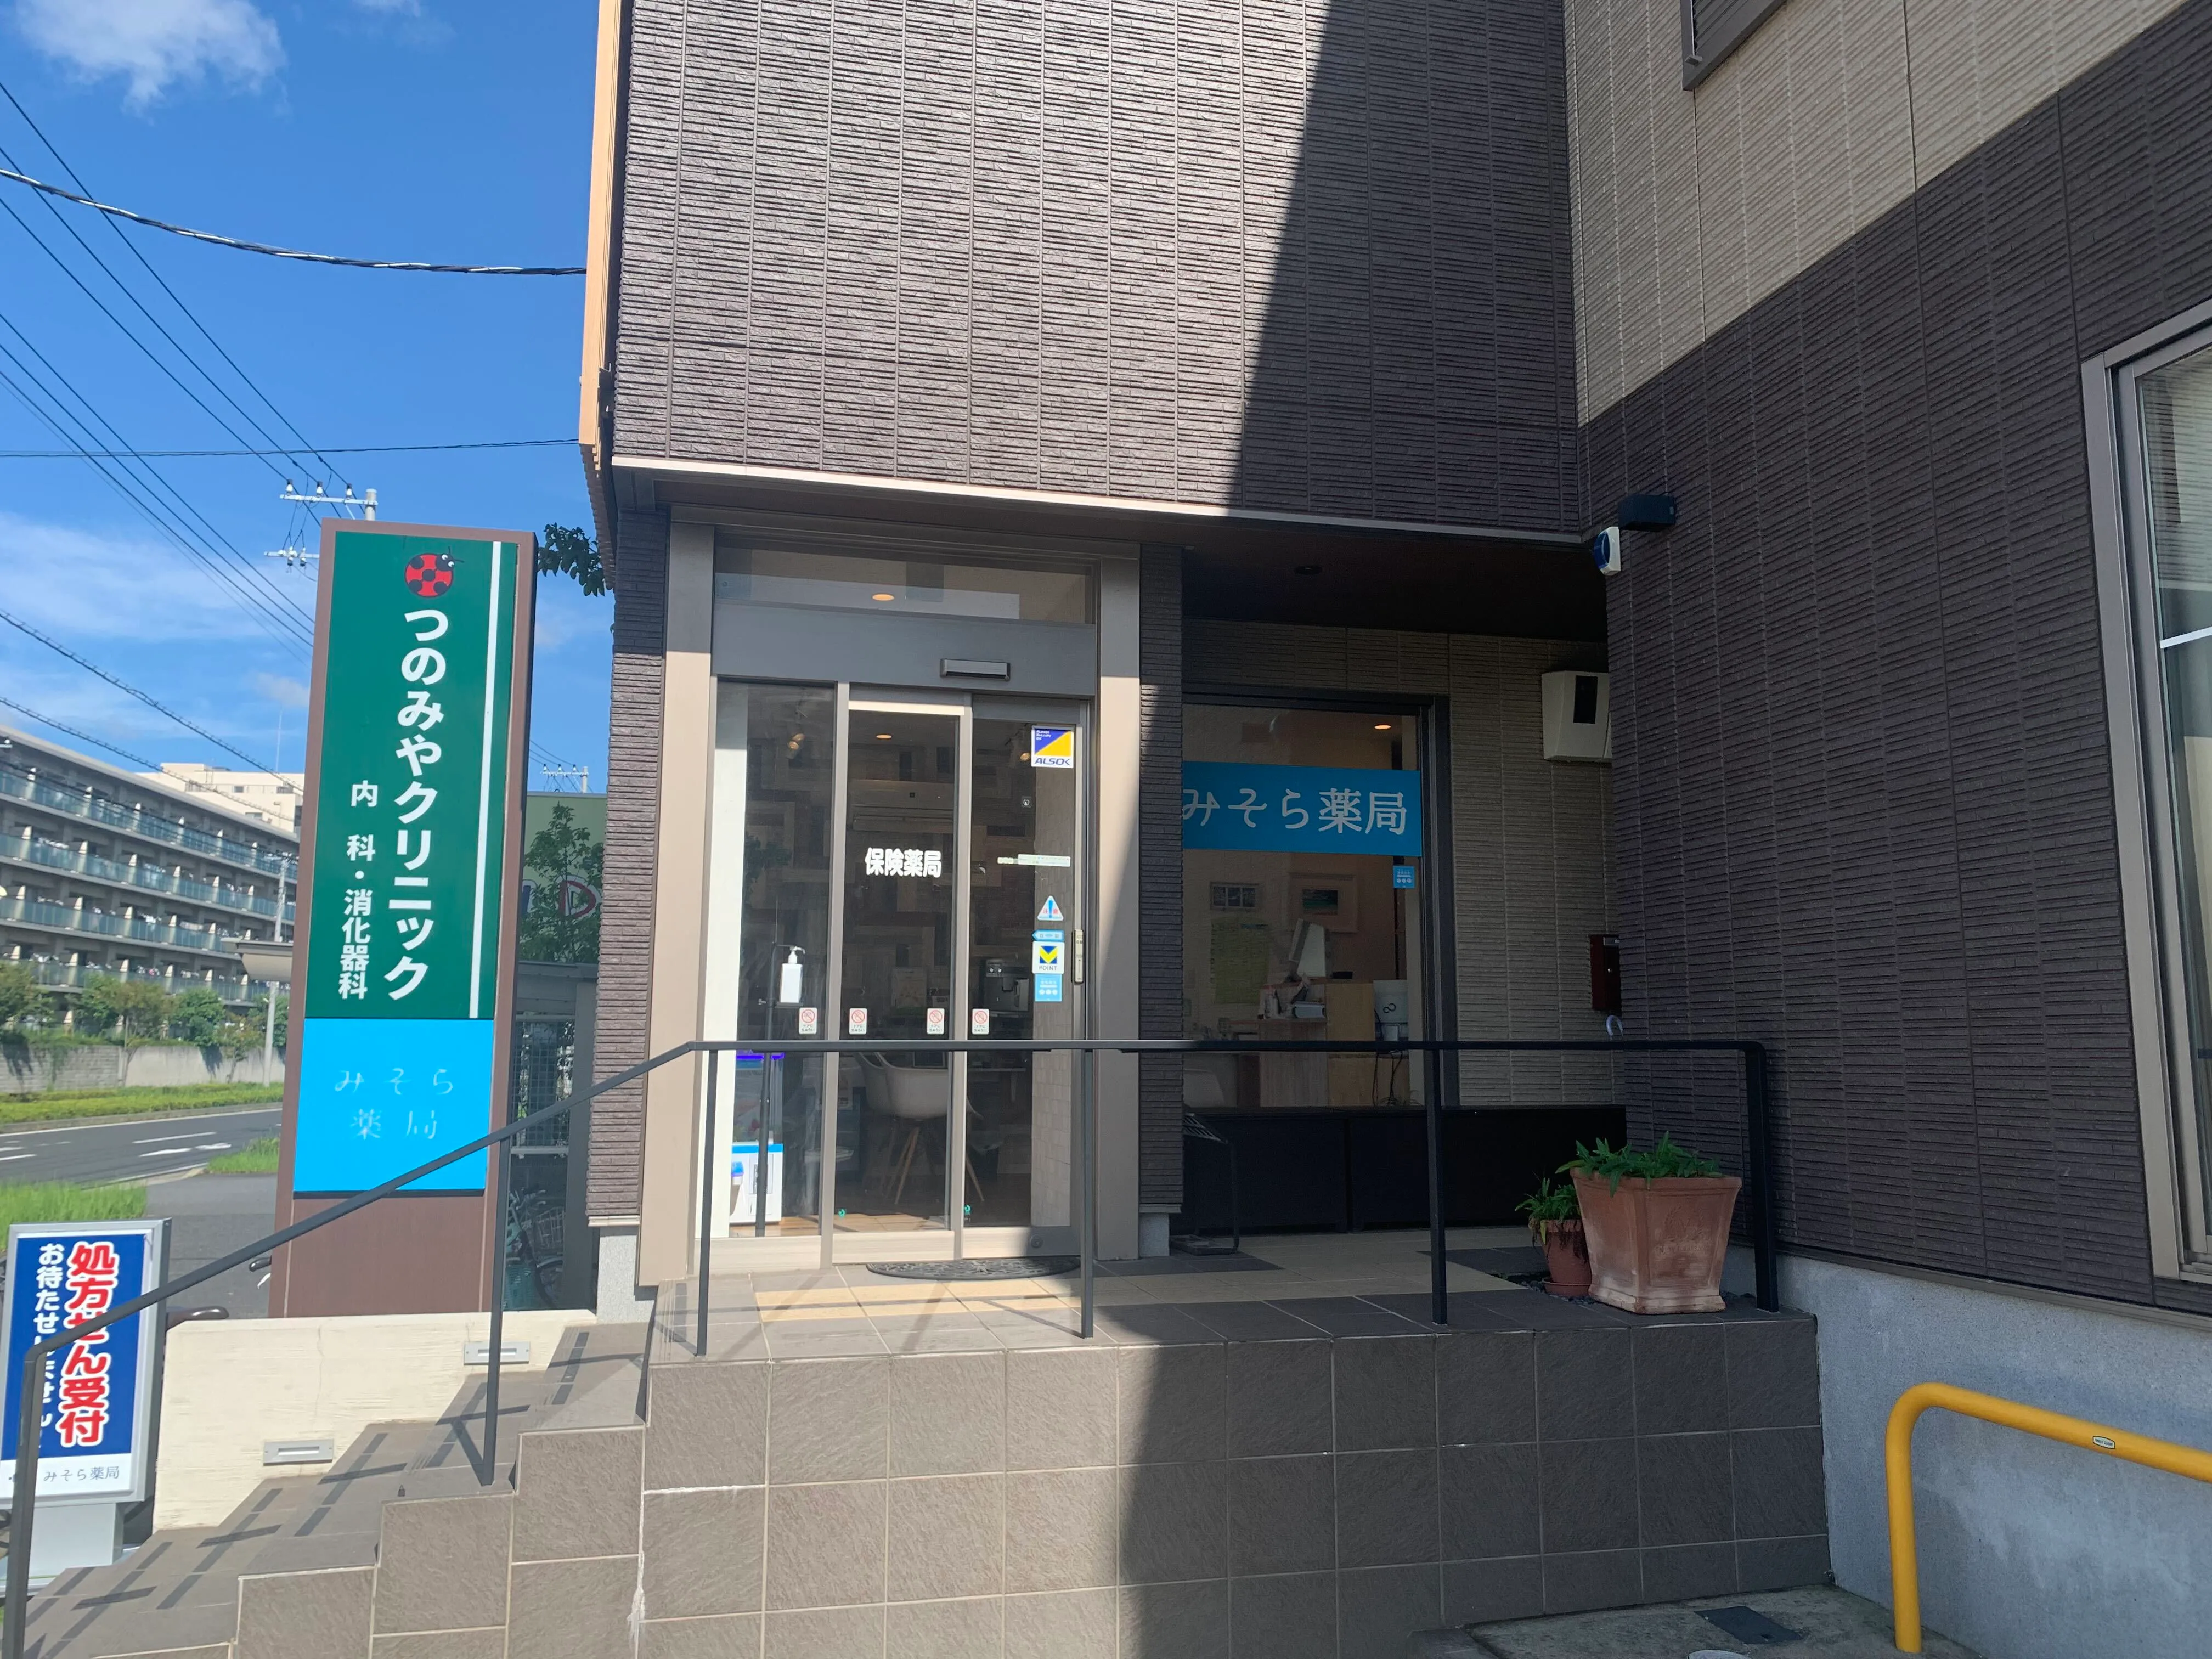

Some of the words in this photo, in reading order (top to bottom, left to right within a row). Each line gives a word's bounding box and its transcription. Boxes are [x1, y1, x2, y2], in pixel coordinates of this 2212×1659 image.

[1035, 758, 1070, 766] ALSOK
[384, 609, 449, 1001] つのみやクリニック
[1183, 787, 1407, 834] みそら薬局
[865, 847, 941, 878] 保険薬局
[334, 1068, 453, 1094] みそら
[58, 1242, 118, 1447] 処方せん受付
[43, 1466, 119, 1482] みそら薬局
